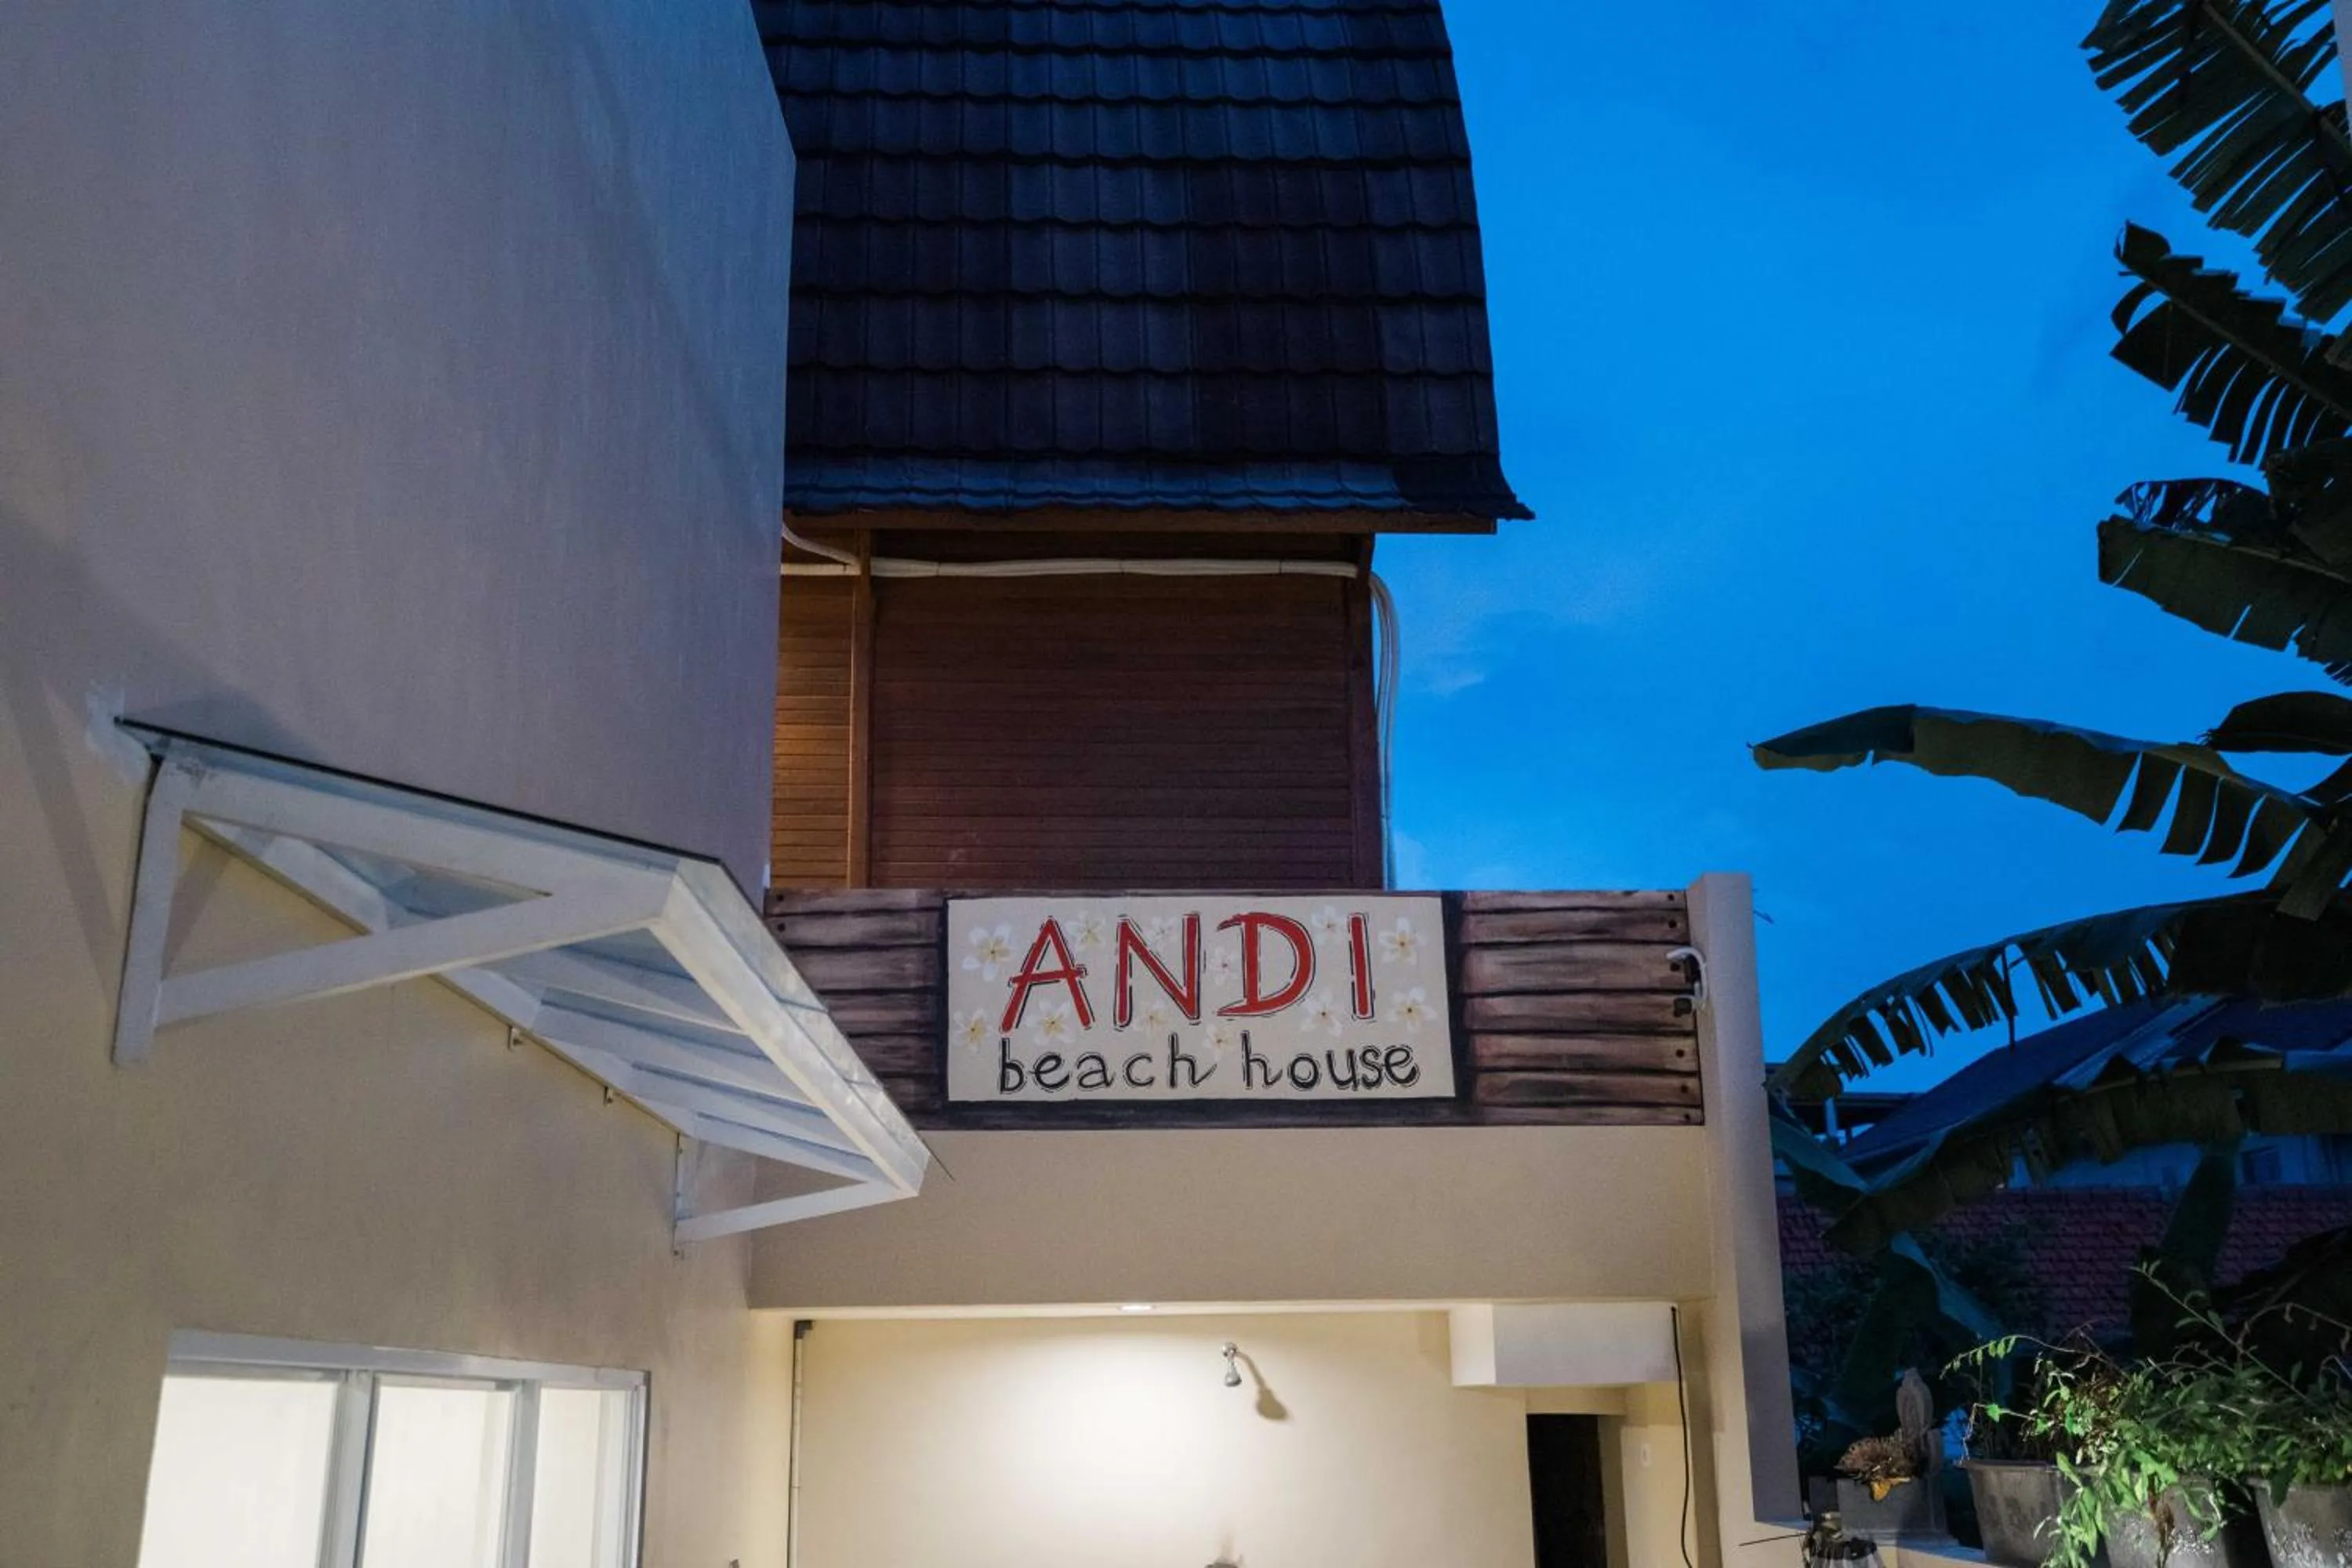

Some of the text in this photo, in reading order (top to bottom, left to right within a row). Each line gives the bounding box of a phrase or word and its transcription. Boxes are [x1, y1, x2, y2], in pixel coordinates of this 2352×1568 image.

[1000, 912, 1375, 1033] ANDI
[998, 1030, 1421, 1094] beach house
